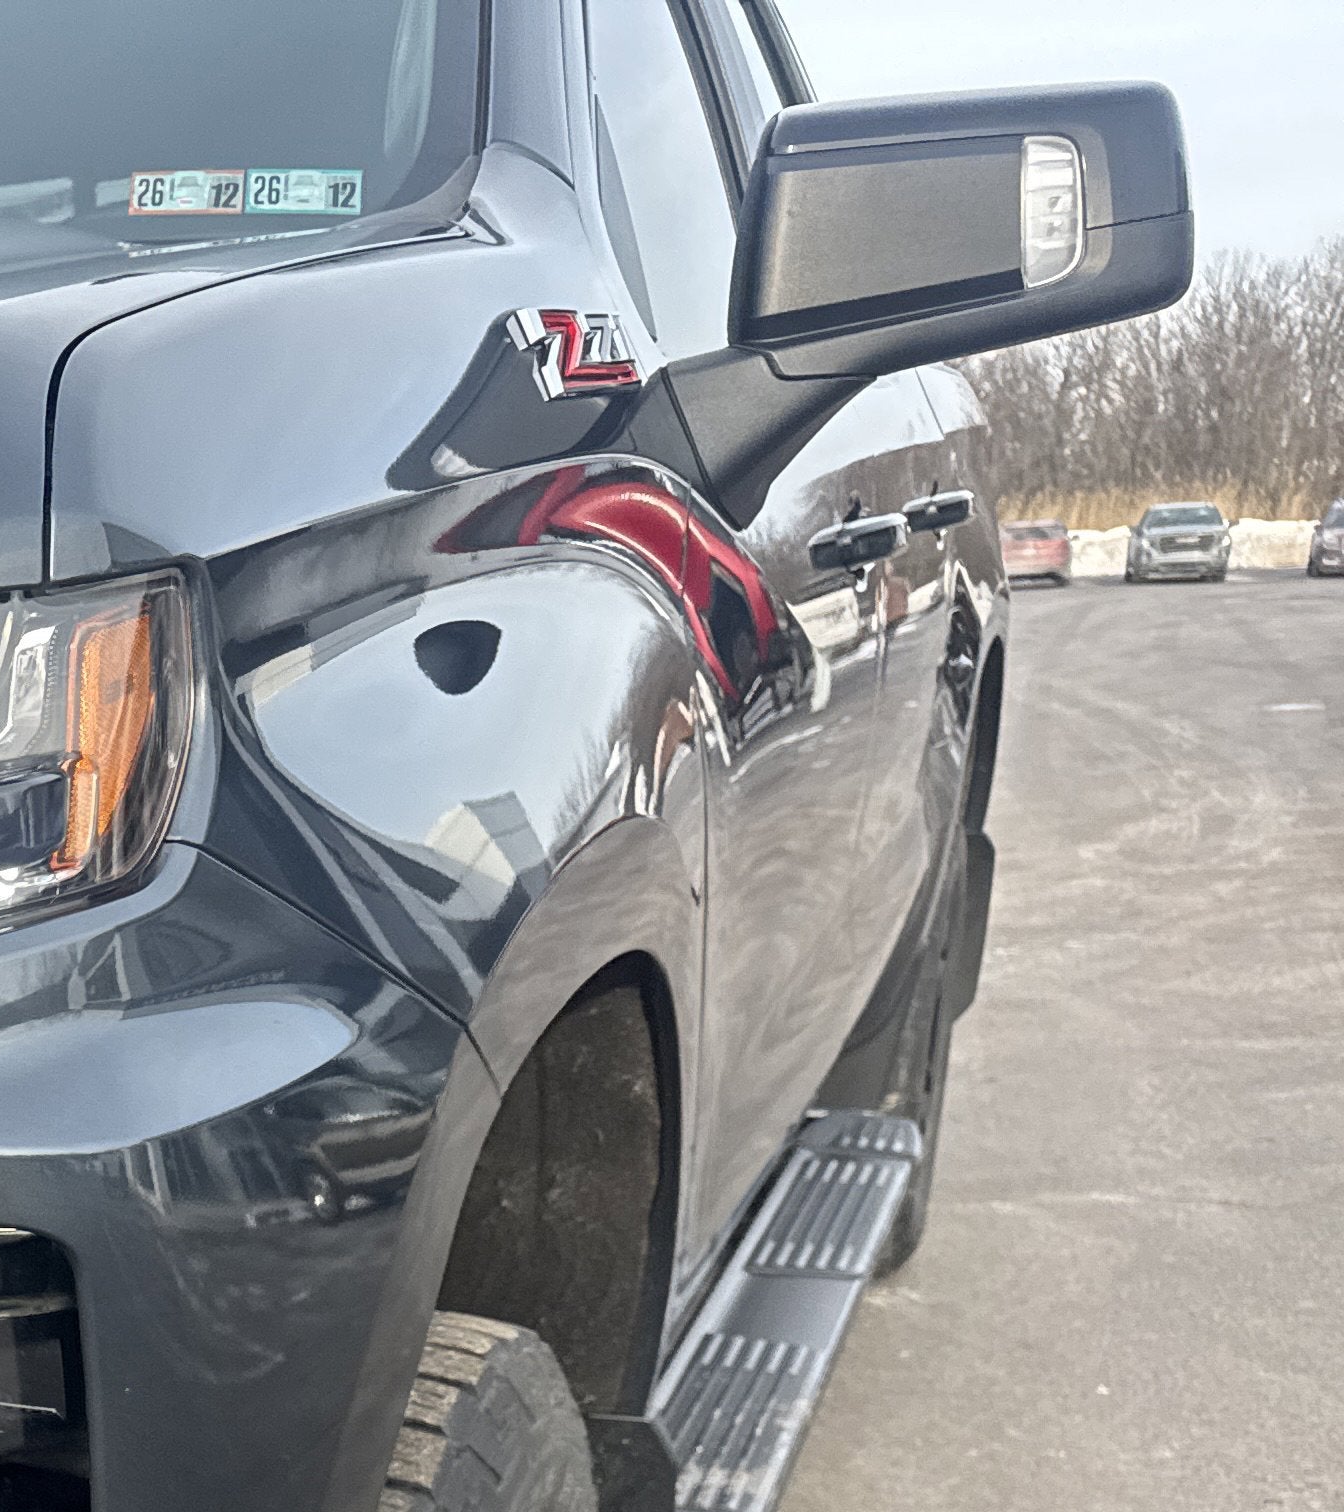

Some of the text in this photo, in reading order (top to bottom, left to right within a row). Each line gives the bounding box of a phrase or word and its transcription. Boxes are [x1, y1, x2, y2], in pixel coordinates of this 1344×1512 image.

[137, 178, 165, 207] 26
[211, 182, 240, 209] 12
[253, 175, 281, 205] 26
[328, 182, 357, 208] 12
[506, 308, 642, 402] Z71
